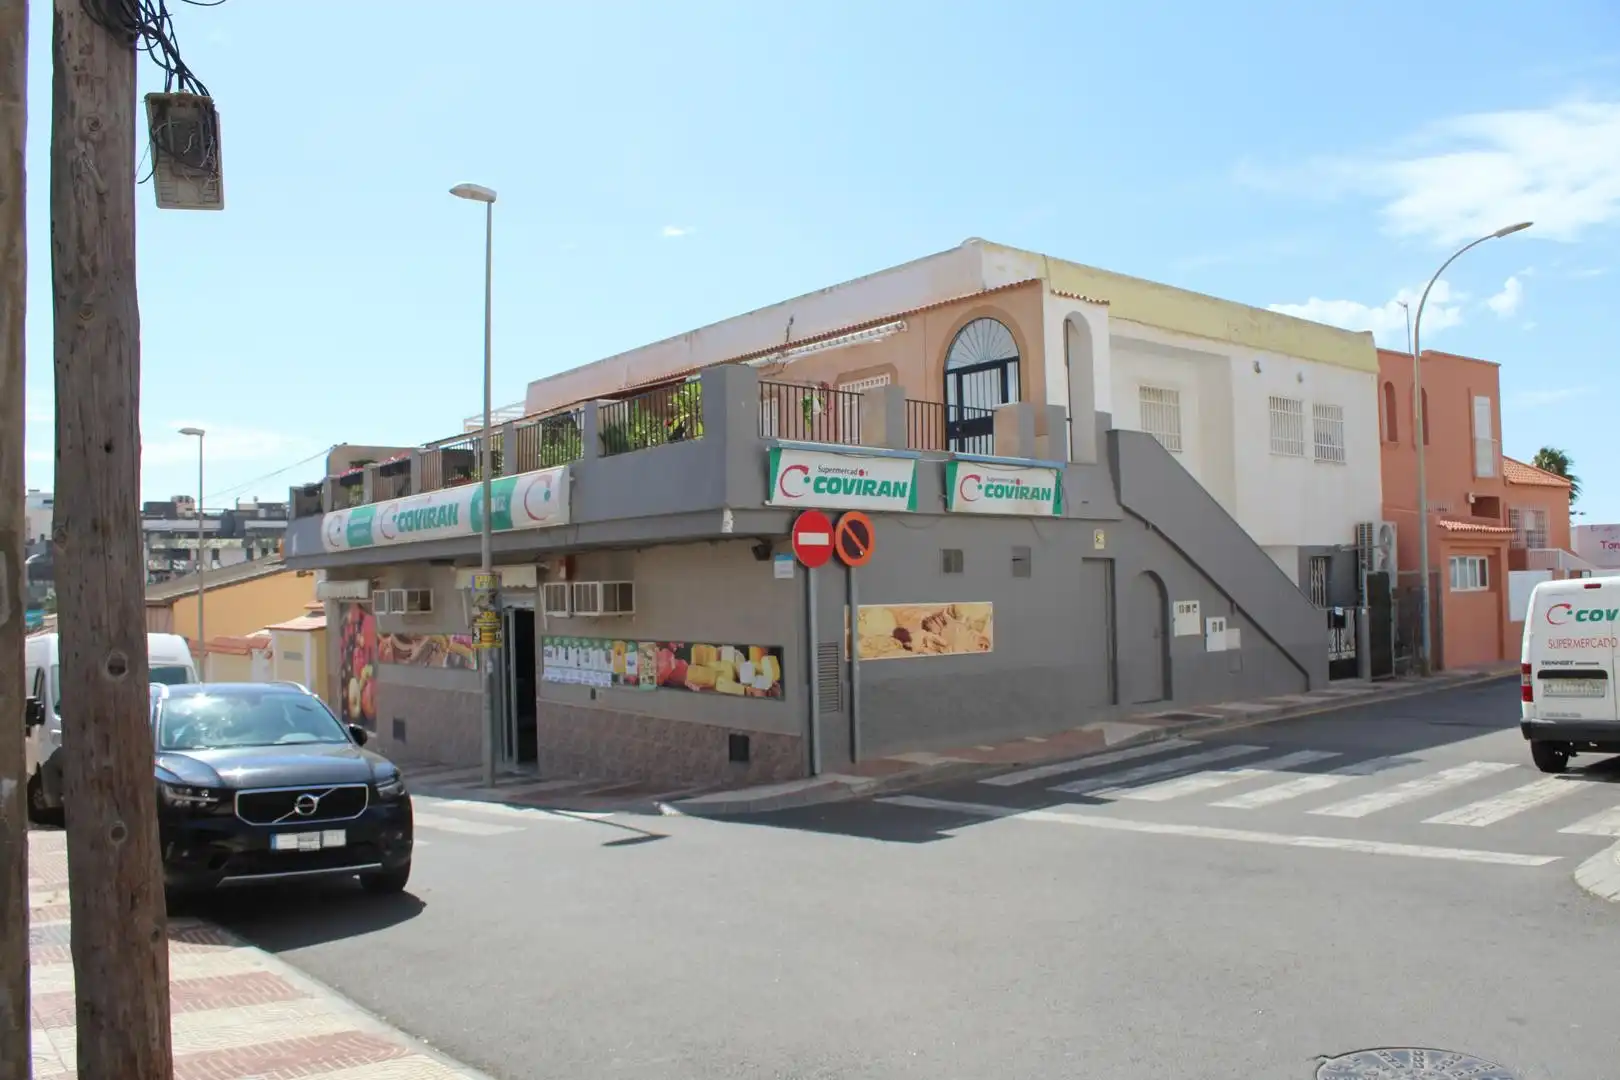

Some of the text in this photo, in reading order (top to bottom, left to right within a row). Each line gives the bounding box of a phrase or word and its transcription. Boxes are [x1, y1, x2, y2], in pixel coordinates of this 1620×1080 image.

[813, 476, 908, 498] COVIRAN
[984, 484, 1051, 501] COVIRAN
[398, 503, 459, 533] COVIRAN
[1548, 637, 1617, 649] SUPERMERCADO
